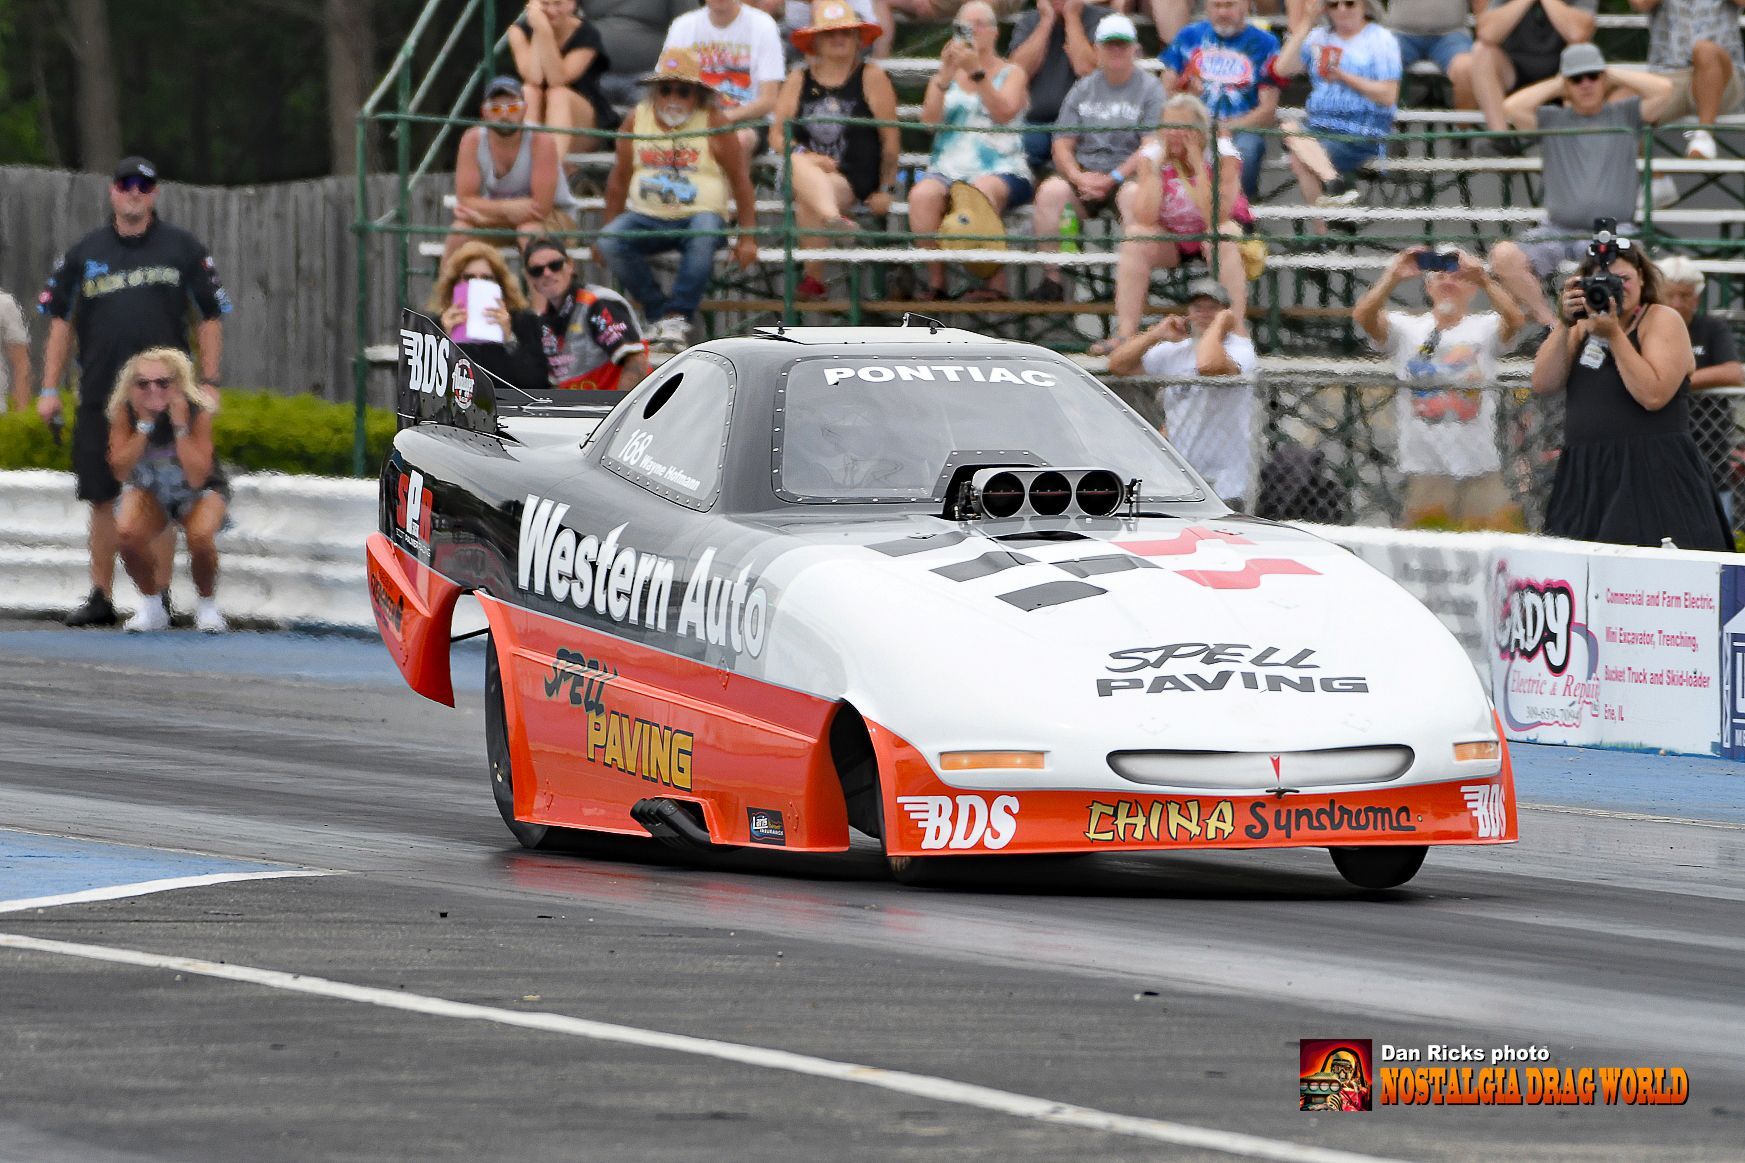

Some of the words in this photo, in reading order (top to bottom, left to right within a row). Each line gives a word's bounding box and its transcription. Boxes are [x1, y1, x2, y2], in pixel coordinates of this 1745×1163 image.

[400, 329, 450, 397] BDS
[823, 366, 1056, 387] PONTIAC
[618, 429, 653, 465] 168
[640, 454, 667, 476] Wayne
[664, 465, 701, 491] Hofmann
[518, 494, 674, 633] Western
[677, 546, 767, 658] Auto
[1606, 588, 1644, 606] Commercial
[1646, 591, 1660, 607] and
[1662, 591, 1682, 608] Farm
[1684, 592, 1715, 612] Electric,
[1105, 643, 1320, 673] SPELL
[1619, 627, 1655, 648] Excavator,
[1658, 630, 1698, 652] Trenching,
[544, 648, 618, 716] SPELL
[1096, 671, 1369, 697] PAVING
[1605, 665, 1625, 682] Bucket
[1627, 667, 1648, 684] Truck
[1649, 669, 1664, 686] and
[1666, 671, 1710, 688] Skid-loader
[587, 710, 694, 792] PAVING
[897, 795, 1019, 850] BDS
[1084, 800, 1235, 843] CHINA
[1245, 799, 1416, 839] Syndrome
[1460, 784, 1506, 838] BDS
